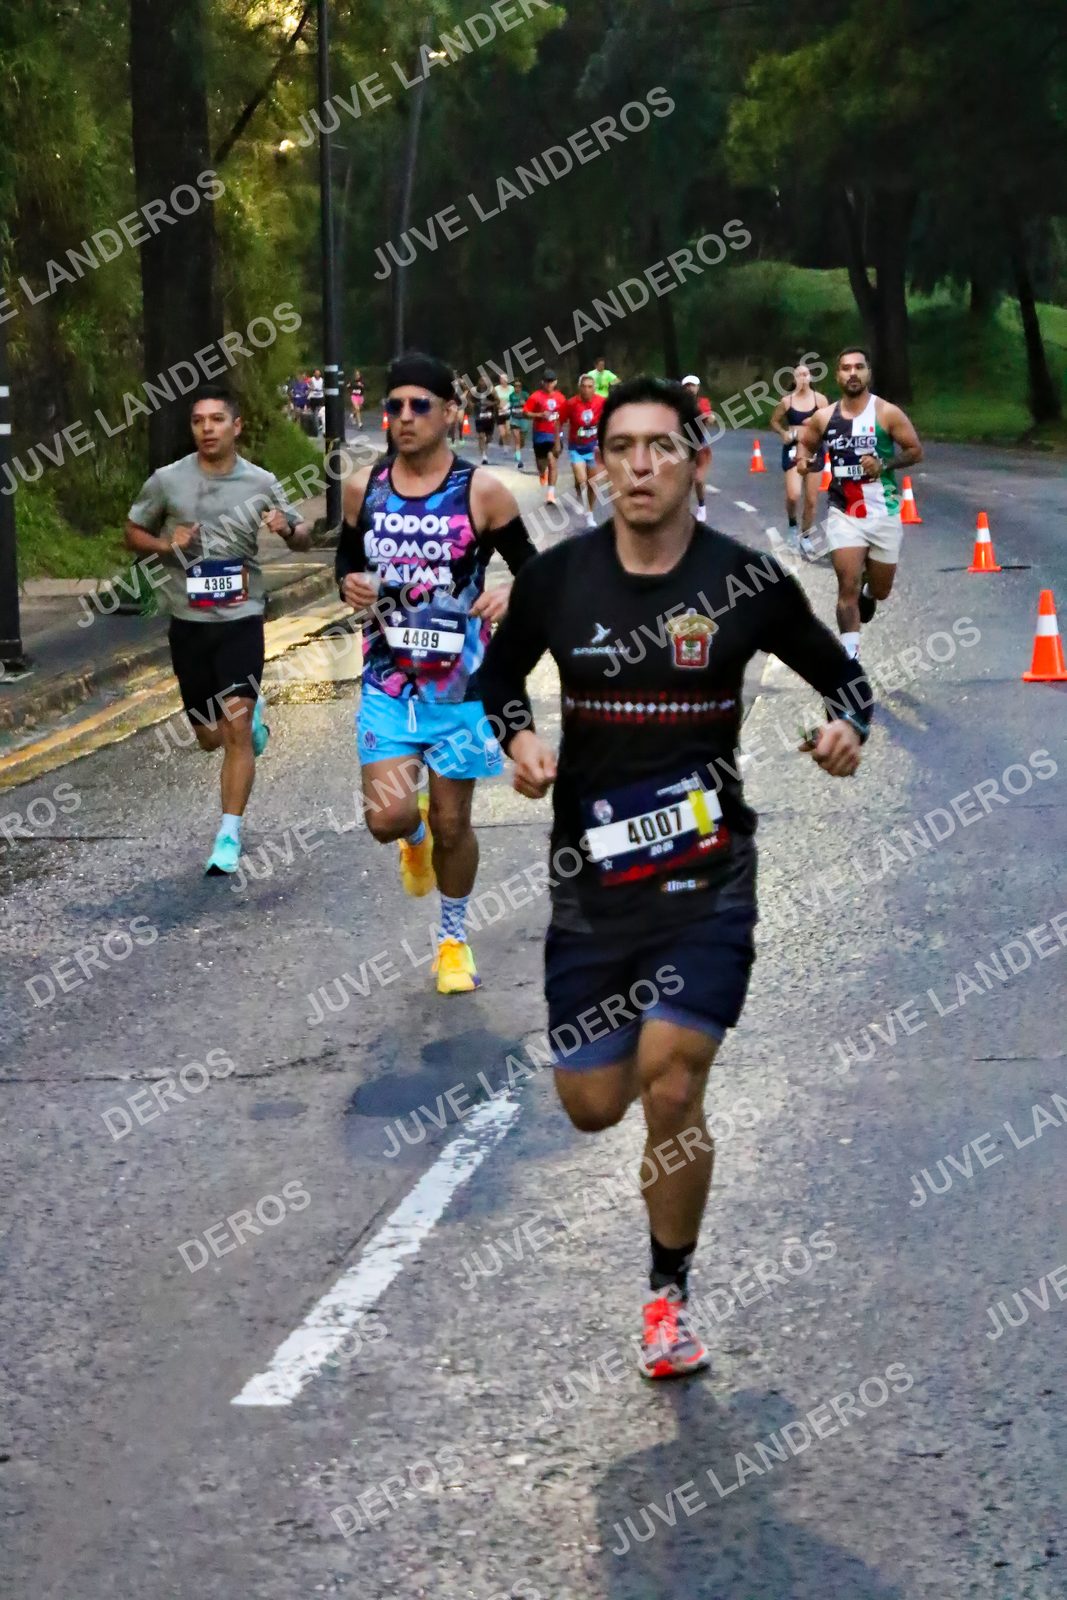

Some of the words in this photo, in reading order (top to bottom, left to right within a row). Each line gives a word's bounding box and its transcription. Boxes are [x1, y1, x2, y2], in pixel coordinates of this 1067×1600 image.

[374, 512, 451, 535] TODOS
[370, 538, 453, 560] SOMOS
[204, 577, 233, 591] 4385
[402, 629, 440, 649] 4489
[627, 806, 683, 845] 4007
